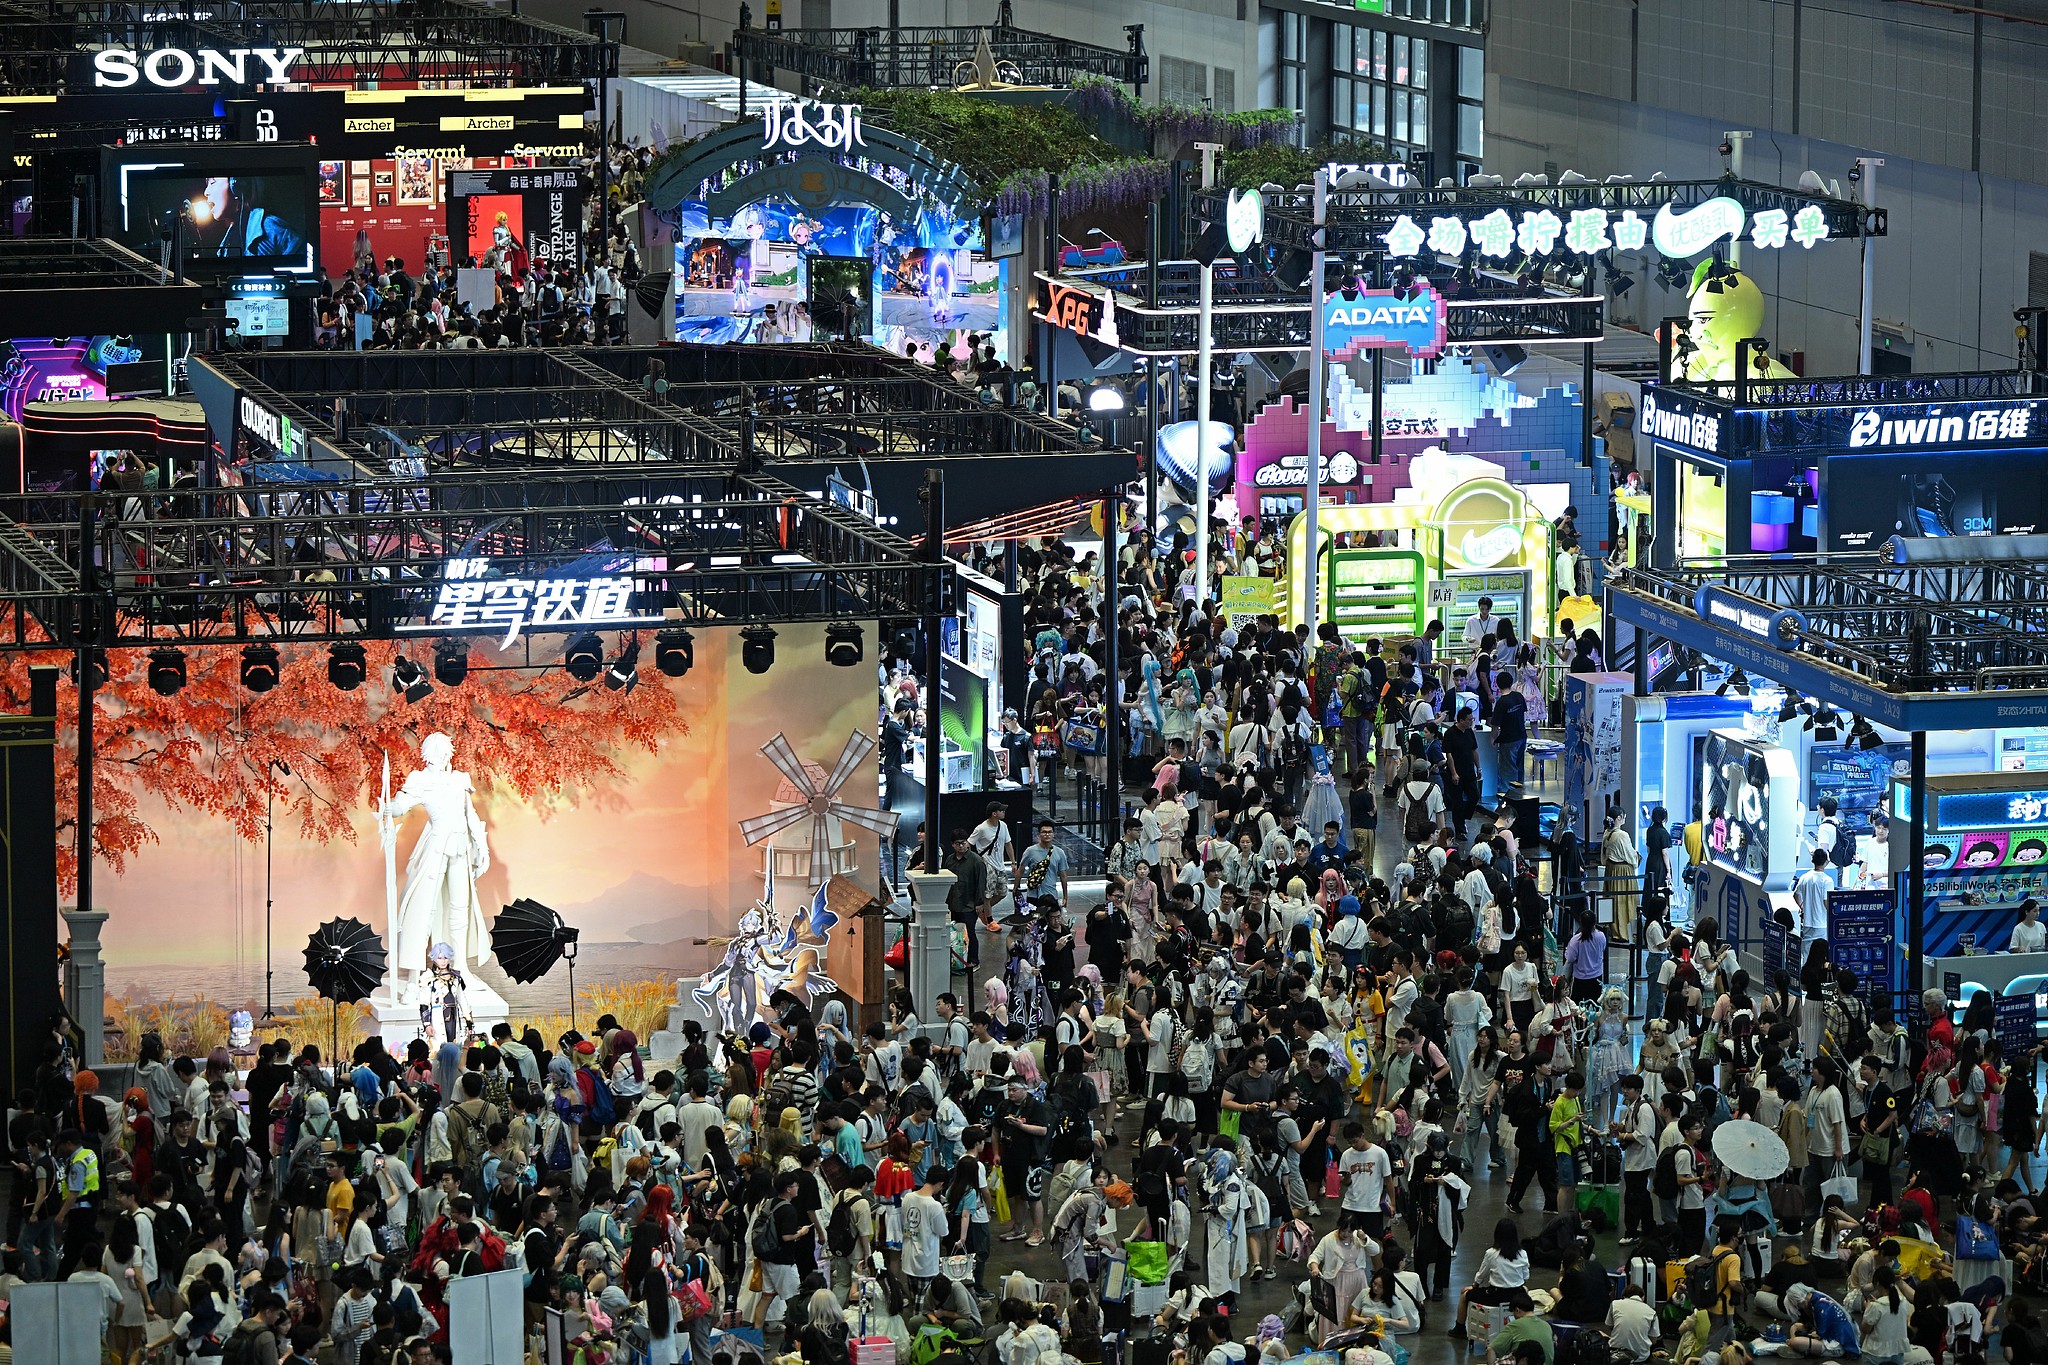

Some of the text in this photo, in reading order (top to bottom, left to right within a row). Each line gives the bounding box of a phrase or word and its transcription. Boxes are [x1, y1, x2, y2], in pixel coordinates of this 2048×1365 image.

[94, 48, 304, 88] SONY
[347, 120, 392, 131] Archer
[467, 118, 511, 129] Archer
[394, 145, 466, 160] Servant
[513, 142, 584, 158] Servant
[551, 192, 564, 262] STRANGE
[1045, 283, 1092, 336] XPG
[1328, 306, 1429, 326] ADATA
[1963, 517, 1992, 530] 3CM
[1433, 588, 1453, 602] 队首
[432, 577, 632, 652] 星穹铁道
[1883, 701, 1900, 719] 3A29
